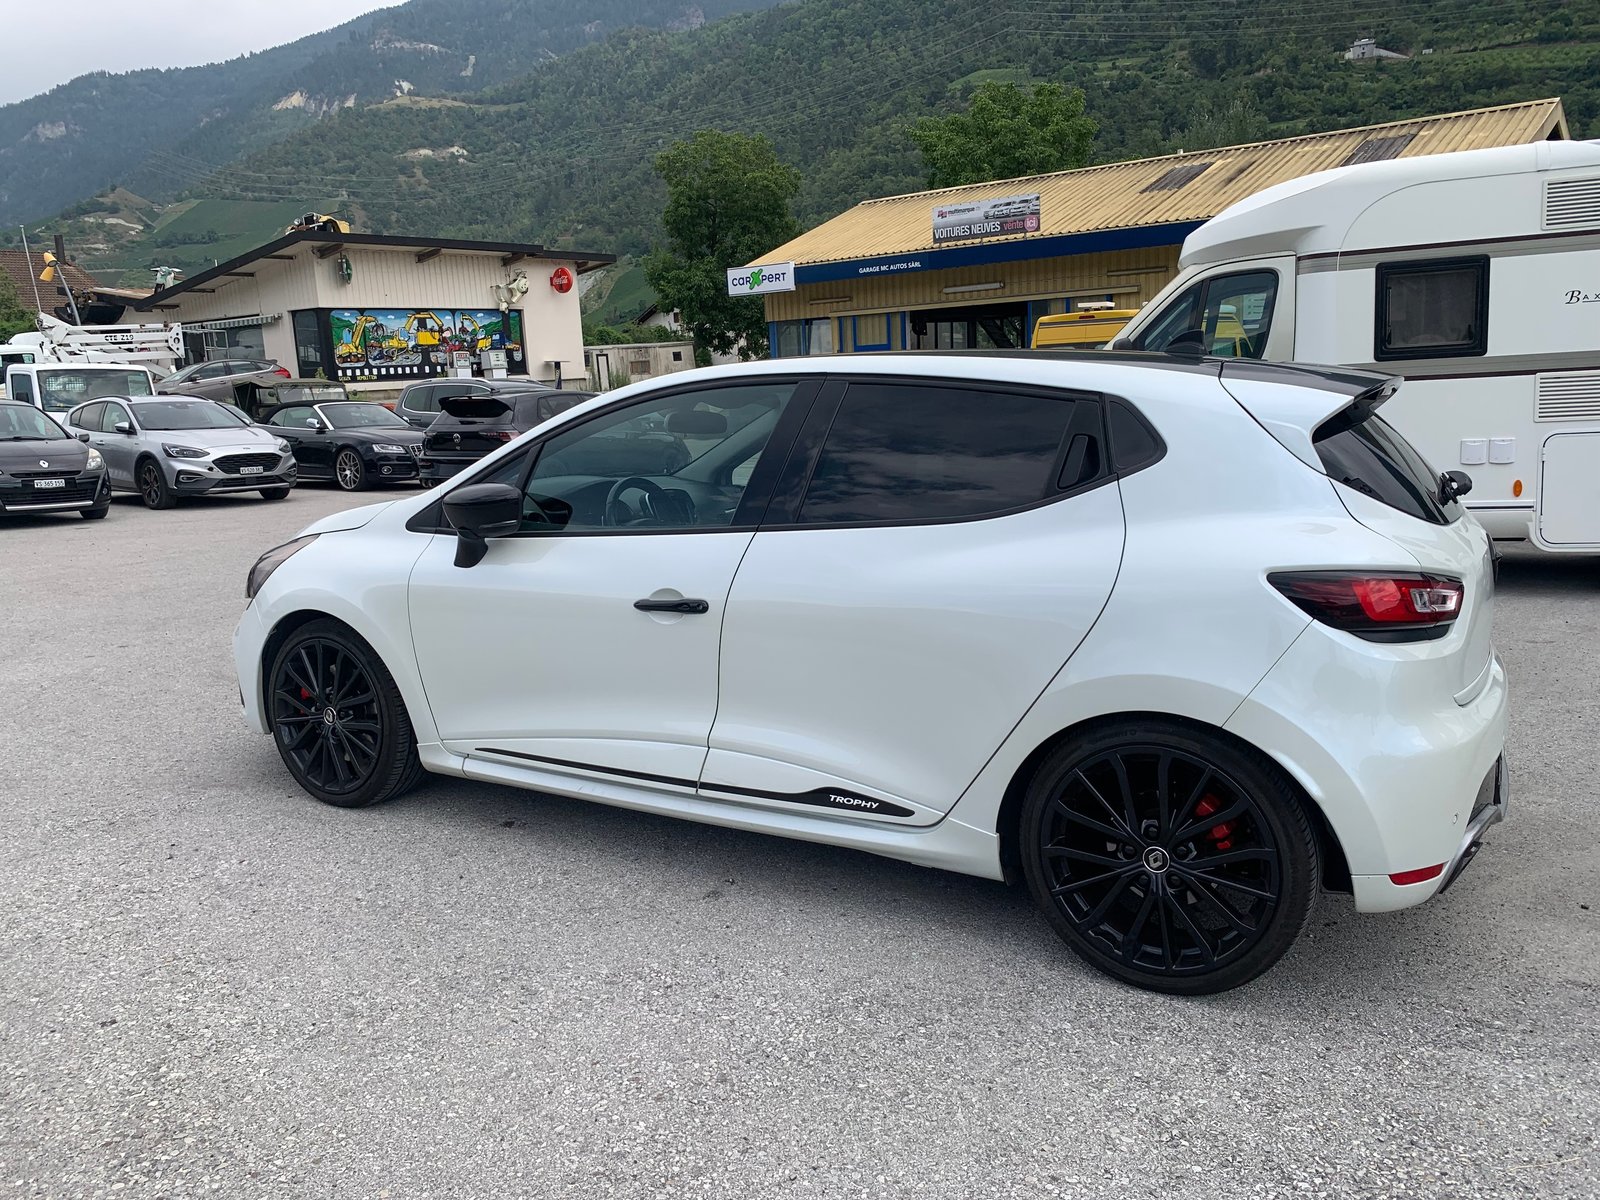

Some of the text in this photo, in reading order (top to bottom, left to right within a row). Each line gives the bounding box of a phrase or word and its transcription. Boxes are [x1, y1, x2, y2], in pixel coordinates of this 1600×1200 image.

[934, 225, 970, 239] VOITURES
[971, 221, 1001, 235] NEUVES
[1026, 217, 1036, 228] ici
[858, 265, 880, 274] GARAGE
[890, 262, 908, 271] AUTOS
[104, 334, 118, 342] CTE
[829, 794, 879, 809] TROPHY
